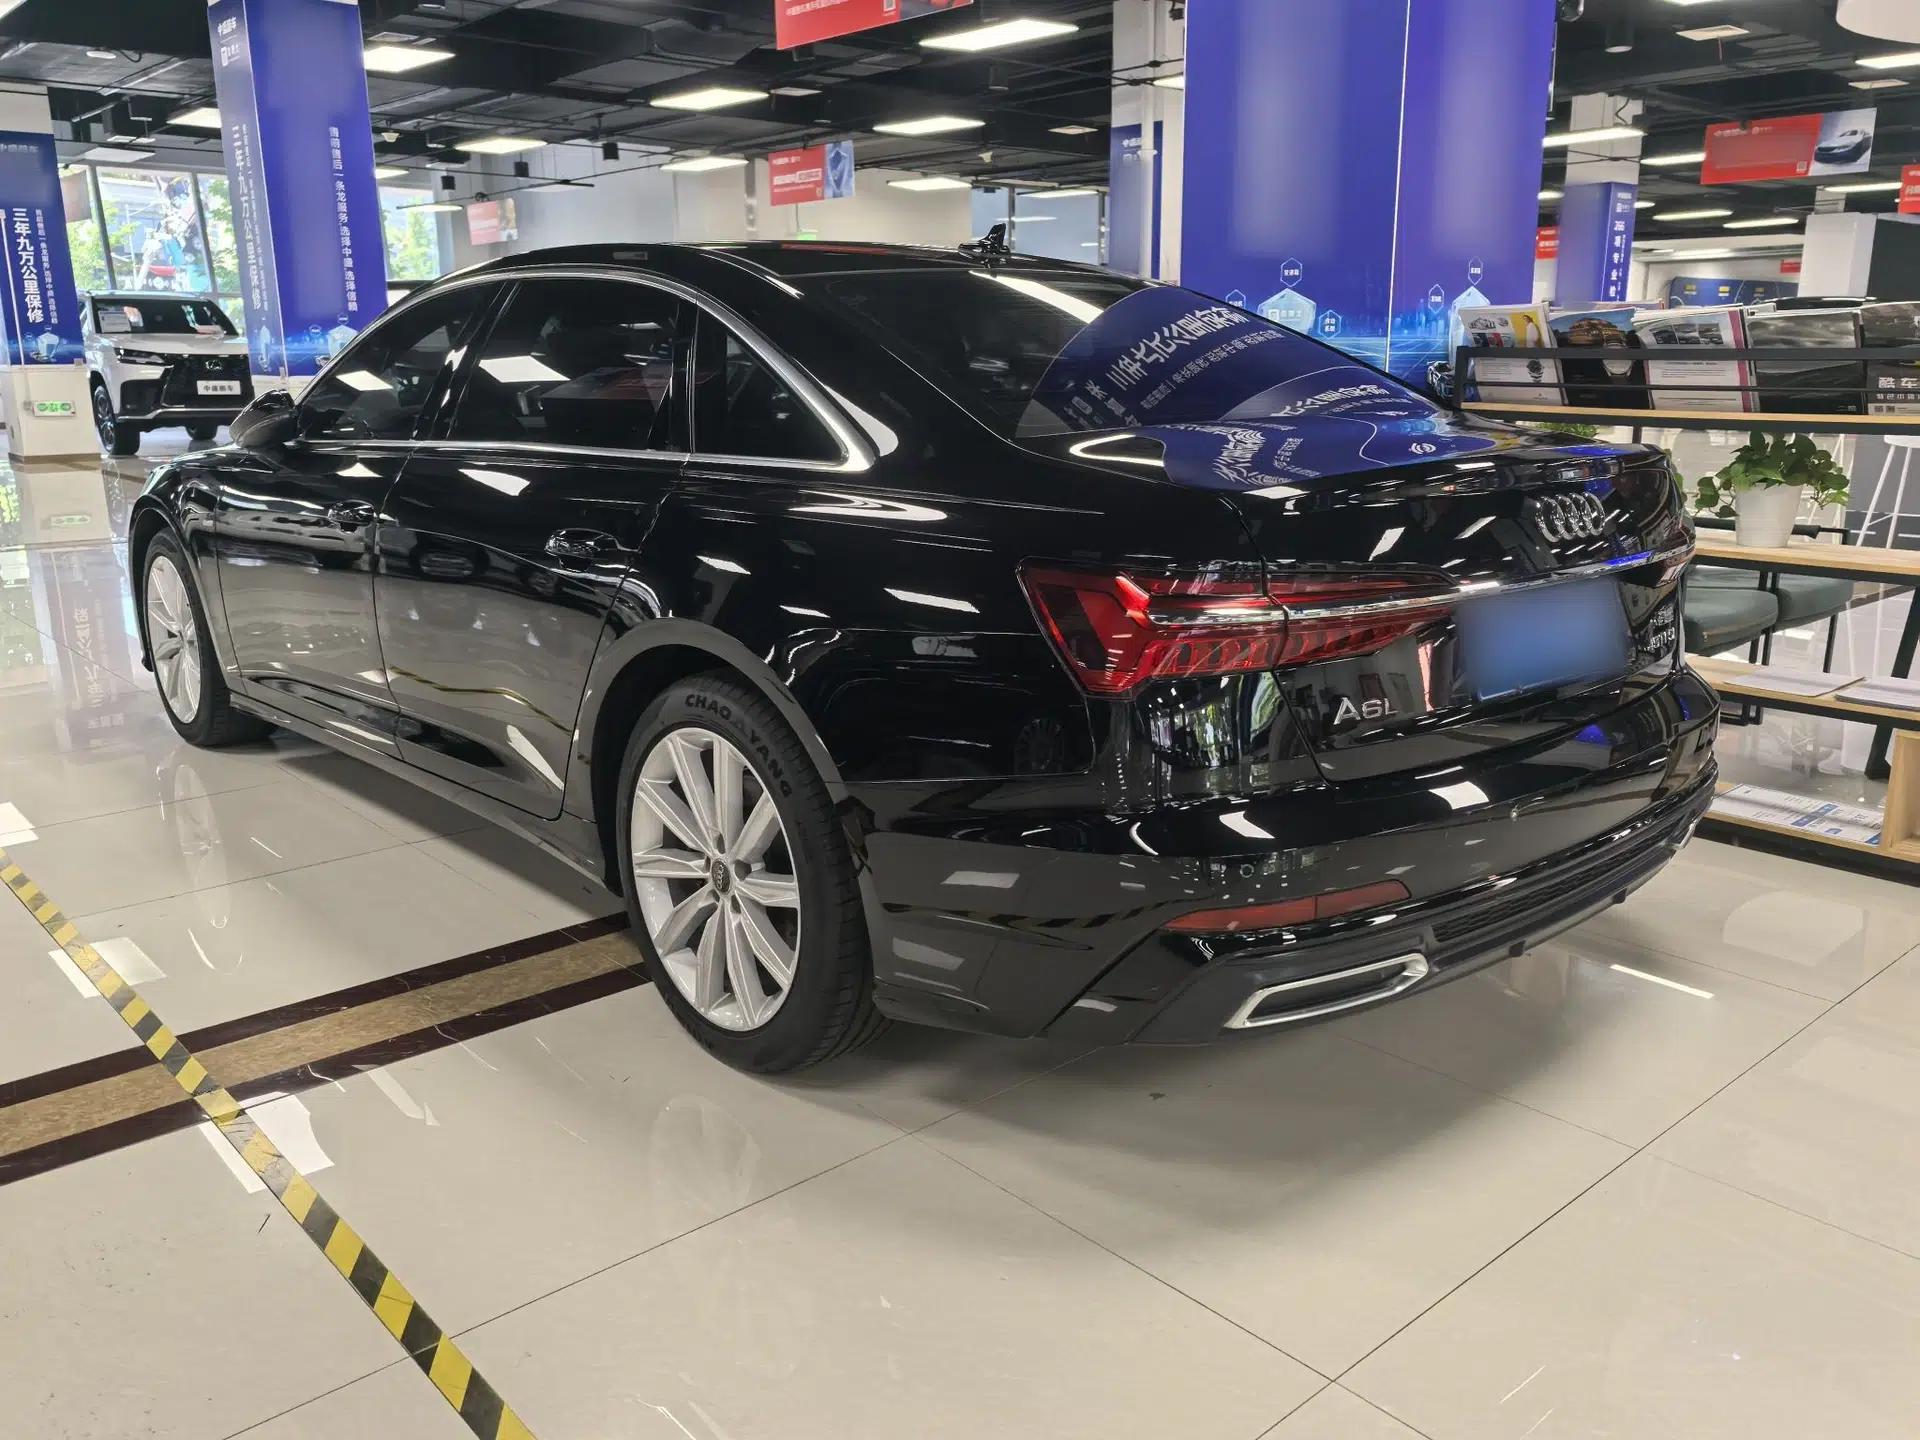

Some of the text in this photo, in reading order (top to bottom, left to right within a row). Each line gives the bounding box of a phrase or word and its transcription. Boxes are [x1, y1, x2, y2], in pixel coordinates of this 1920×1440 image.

[13, 208, 44, 323] 三年九万公里保修
[684, 694, 792, 797] CHAO YANG
[1333, 697, 1399, 725] A6L
